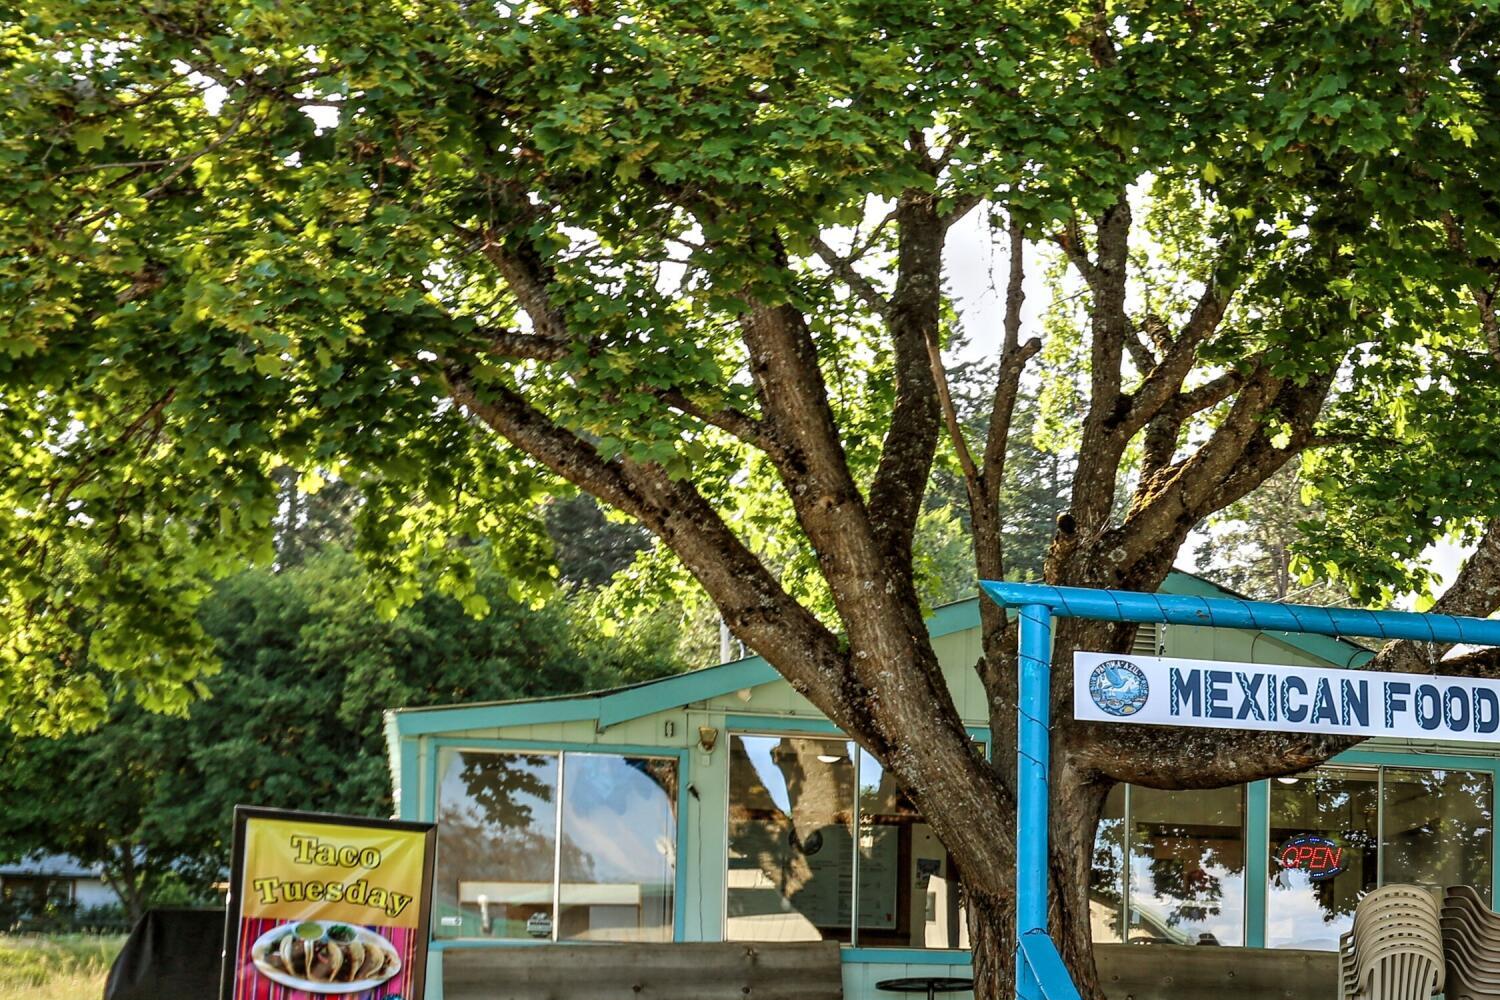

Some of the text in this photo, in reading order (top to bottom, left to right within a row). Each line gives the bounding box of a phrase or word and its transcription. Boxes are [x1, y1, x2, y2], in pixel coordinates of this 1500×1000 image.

[1168, 667, 1500, 734] MEXICAN FOOD
[290, 834, 381, 869] Taco
[1281, 846, 1342, 869] OPEN
[253, 876, 413, 917] Tuesday
